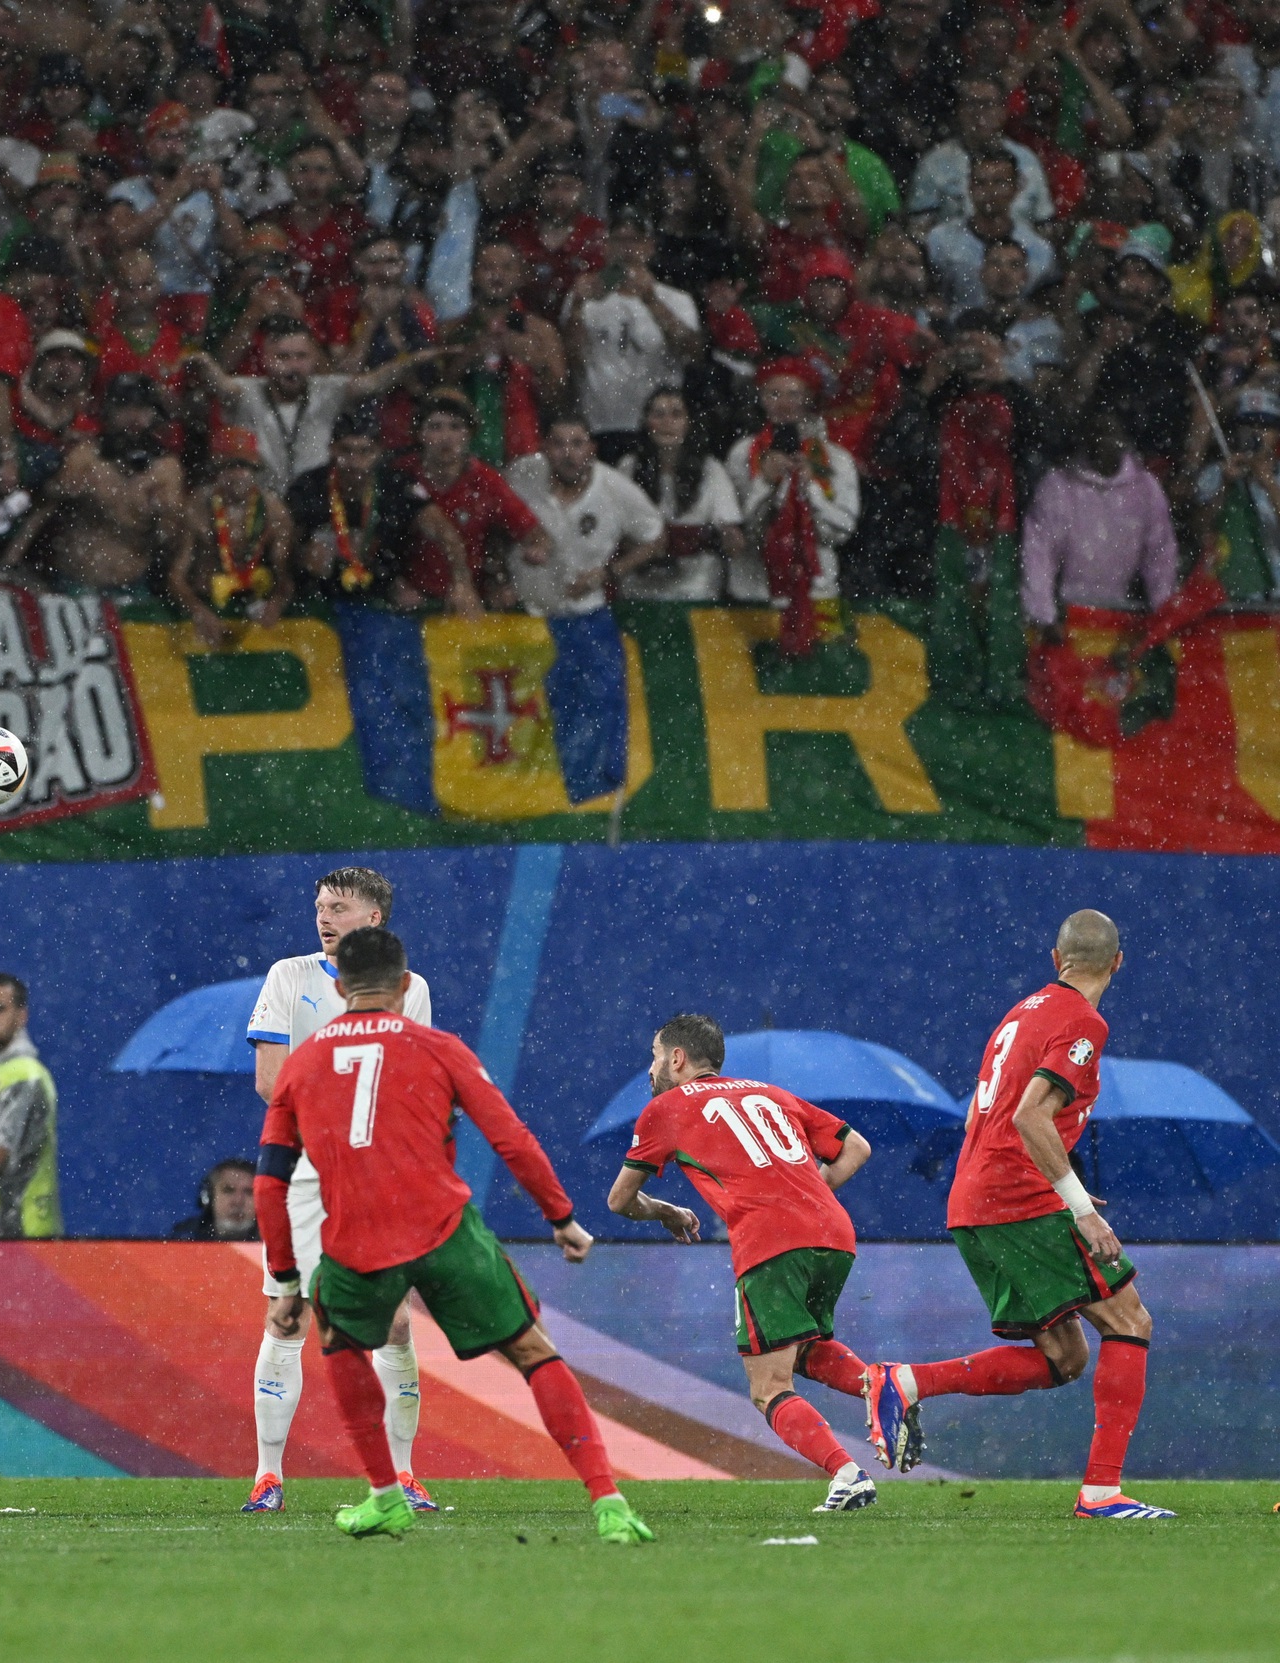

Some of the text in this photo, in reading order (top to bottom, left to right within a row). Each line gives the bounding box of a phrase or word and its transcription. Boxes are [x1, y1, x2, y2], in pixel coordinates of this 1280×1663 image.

[314, 1018, 405, 1043] RONALDO
[679, 1079, 770, 1097] BERNARDO
[977, 1020, 1020, 1114] 3
[333, 1042, 384, 1149] 7
[701, 1094, 809, 1169] 10
[258, 1378, 284, 1388] CZE
